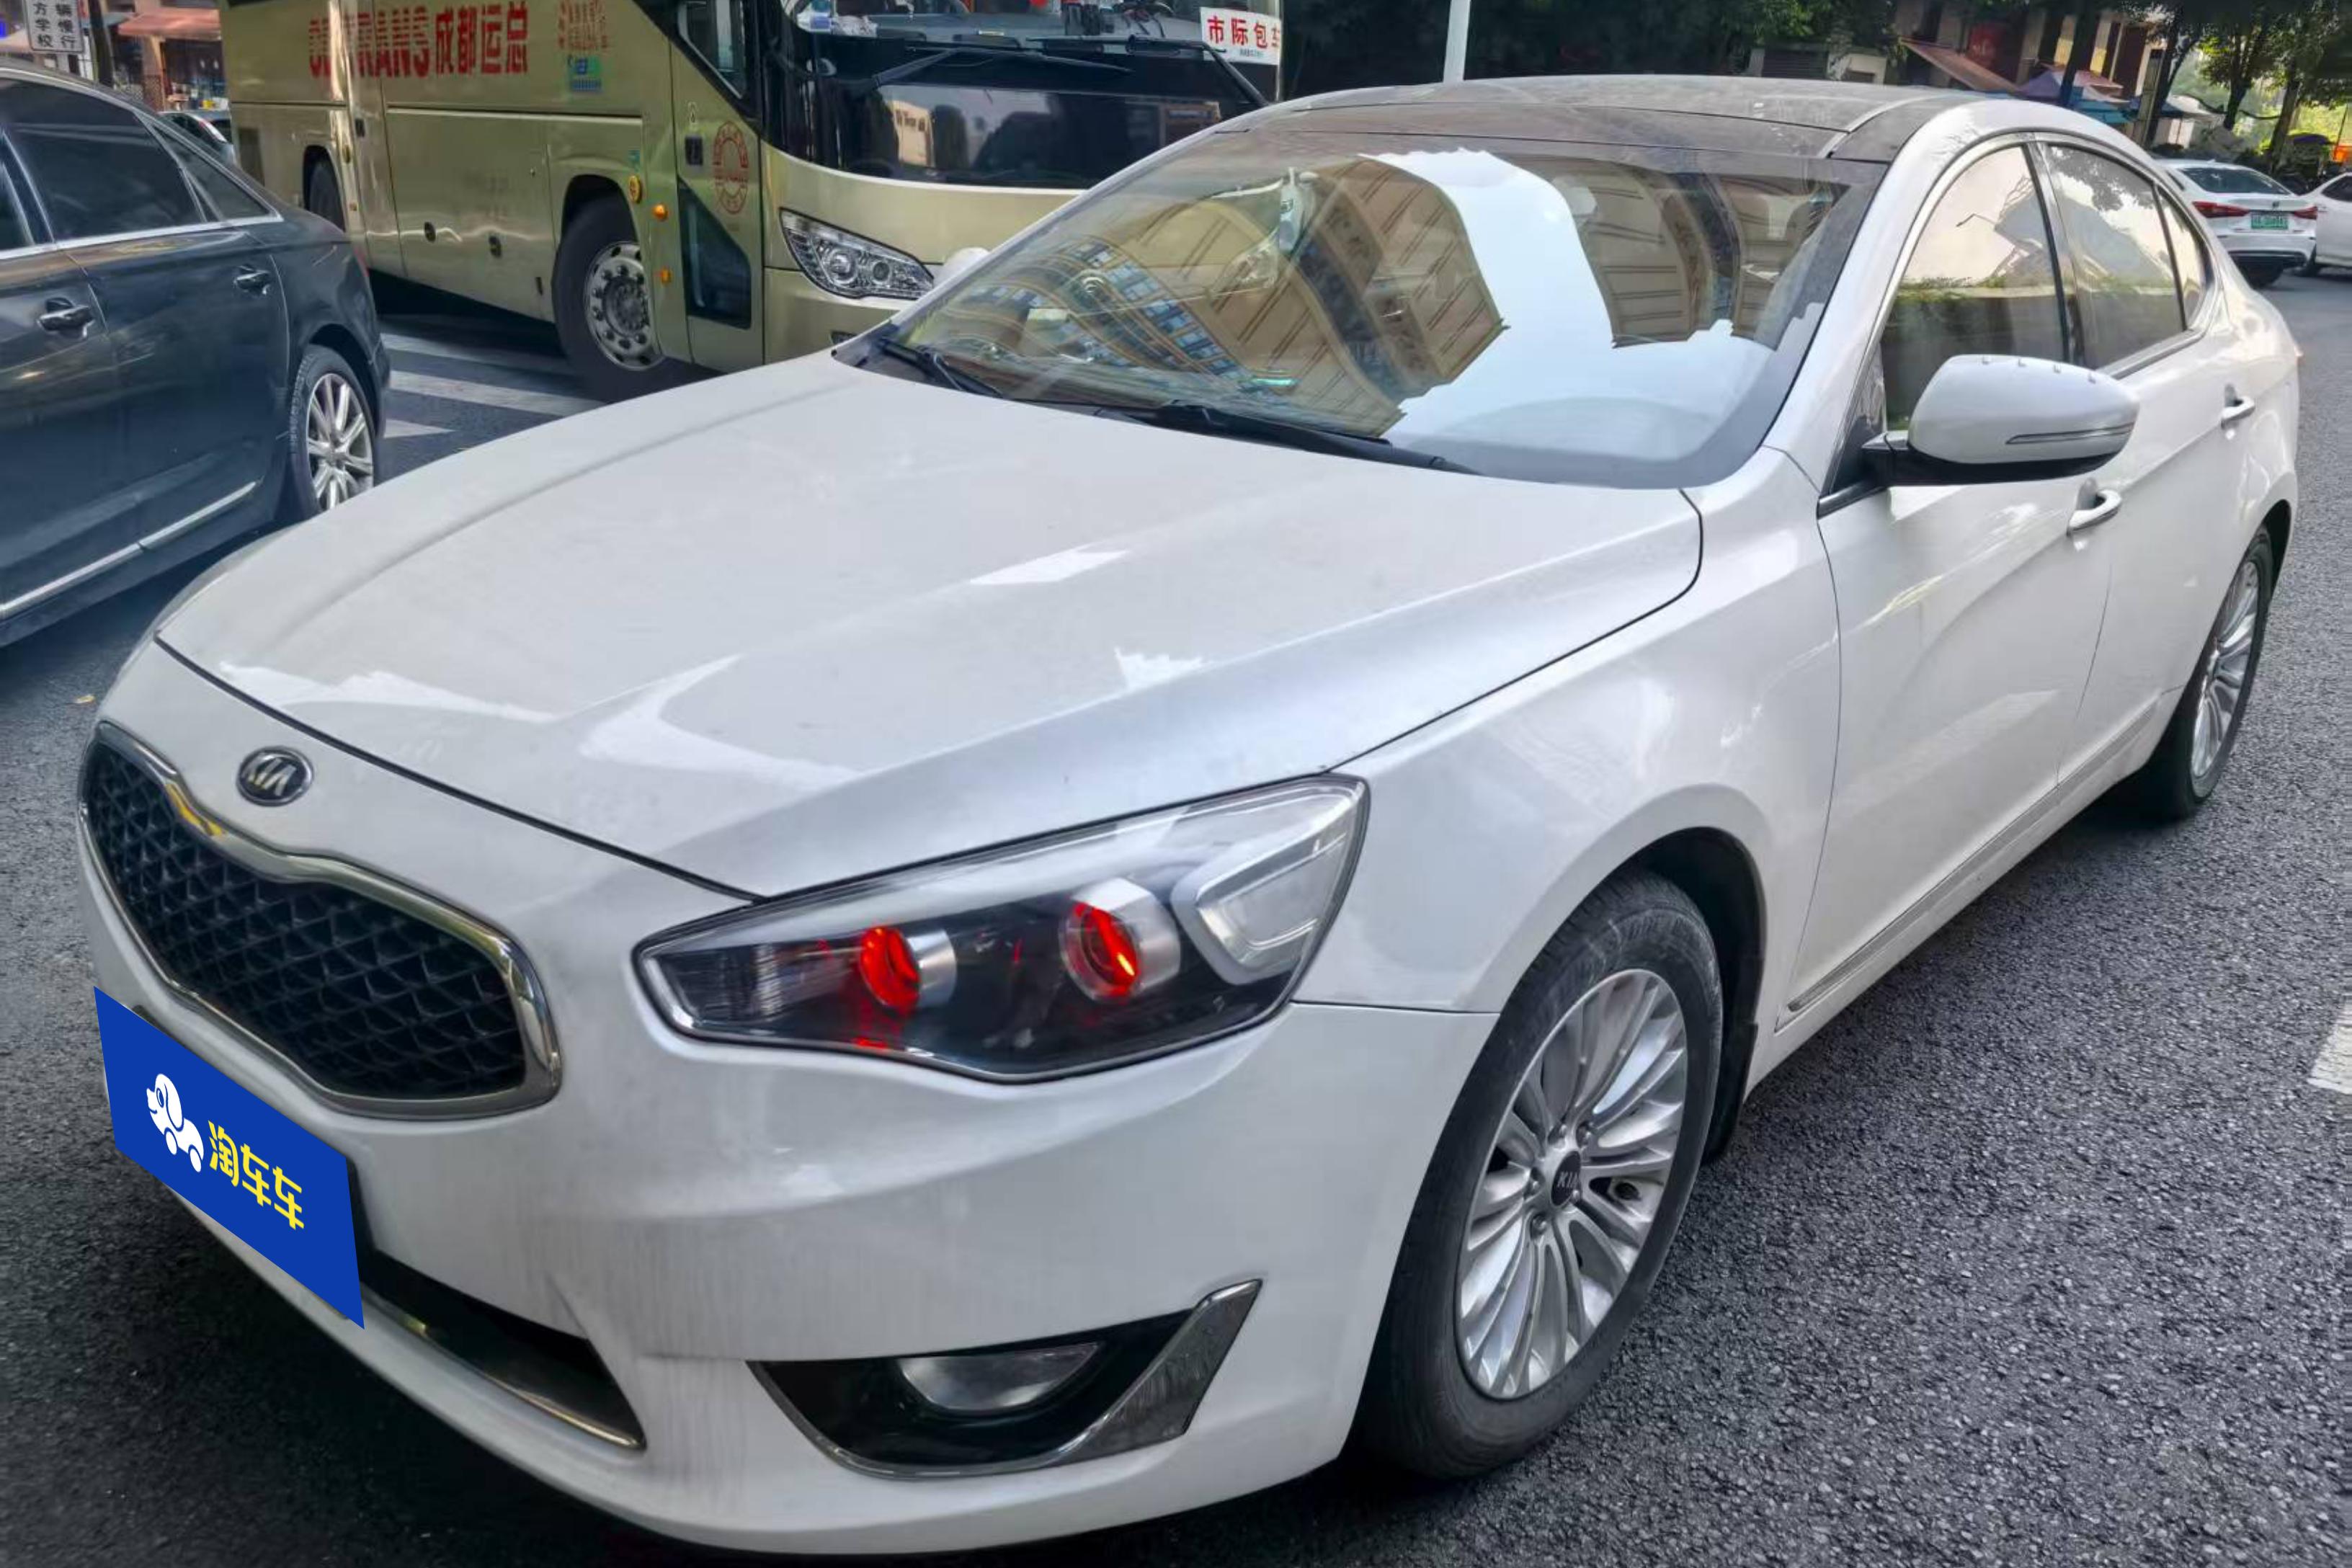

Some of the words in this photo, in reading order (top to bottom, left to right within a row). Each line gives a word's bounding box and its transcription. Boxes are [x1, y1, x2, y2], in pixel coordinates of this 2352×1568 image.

[33, 0, 53, 48] 方学校
[55, 0, 76, 48] 辆慢行
[1557, 1171, 1580, 1188] KIA
